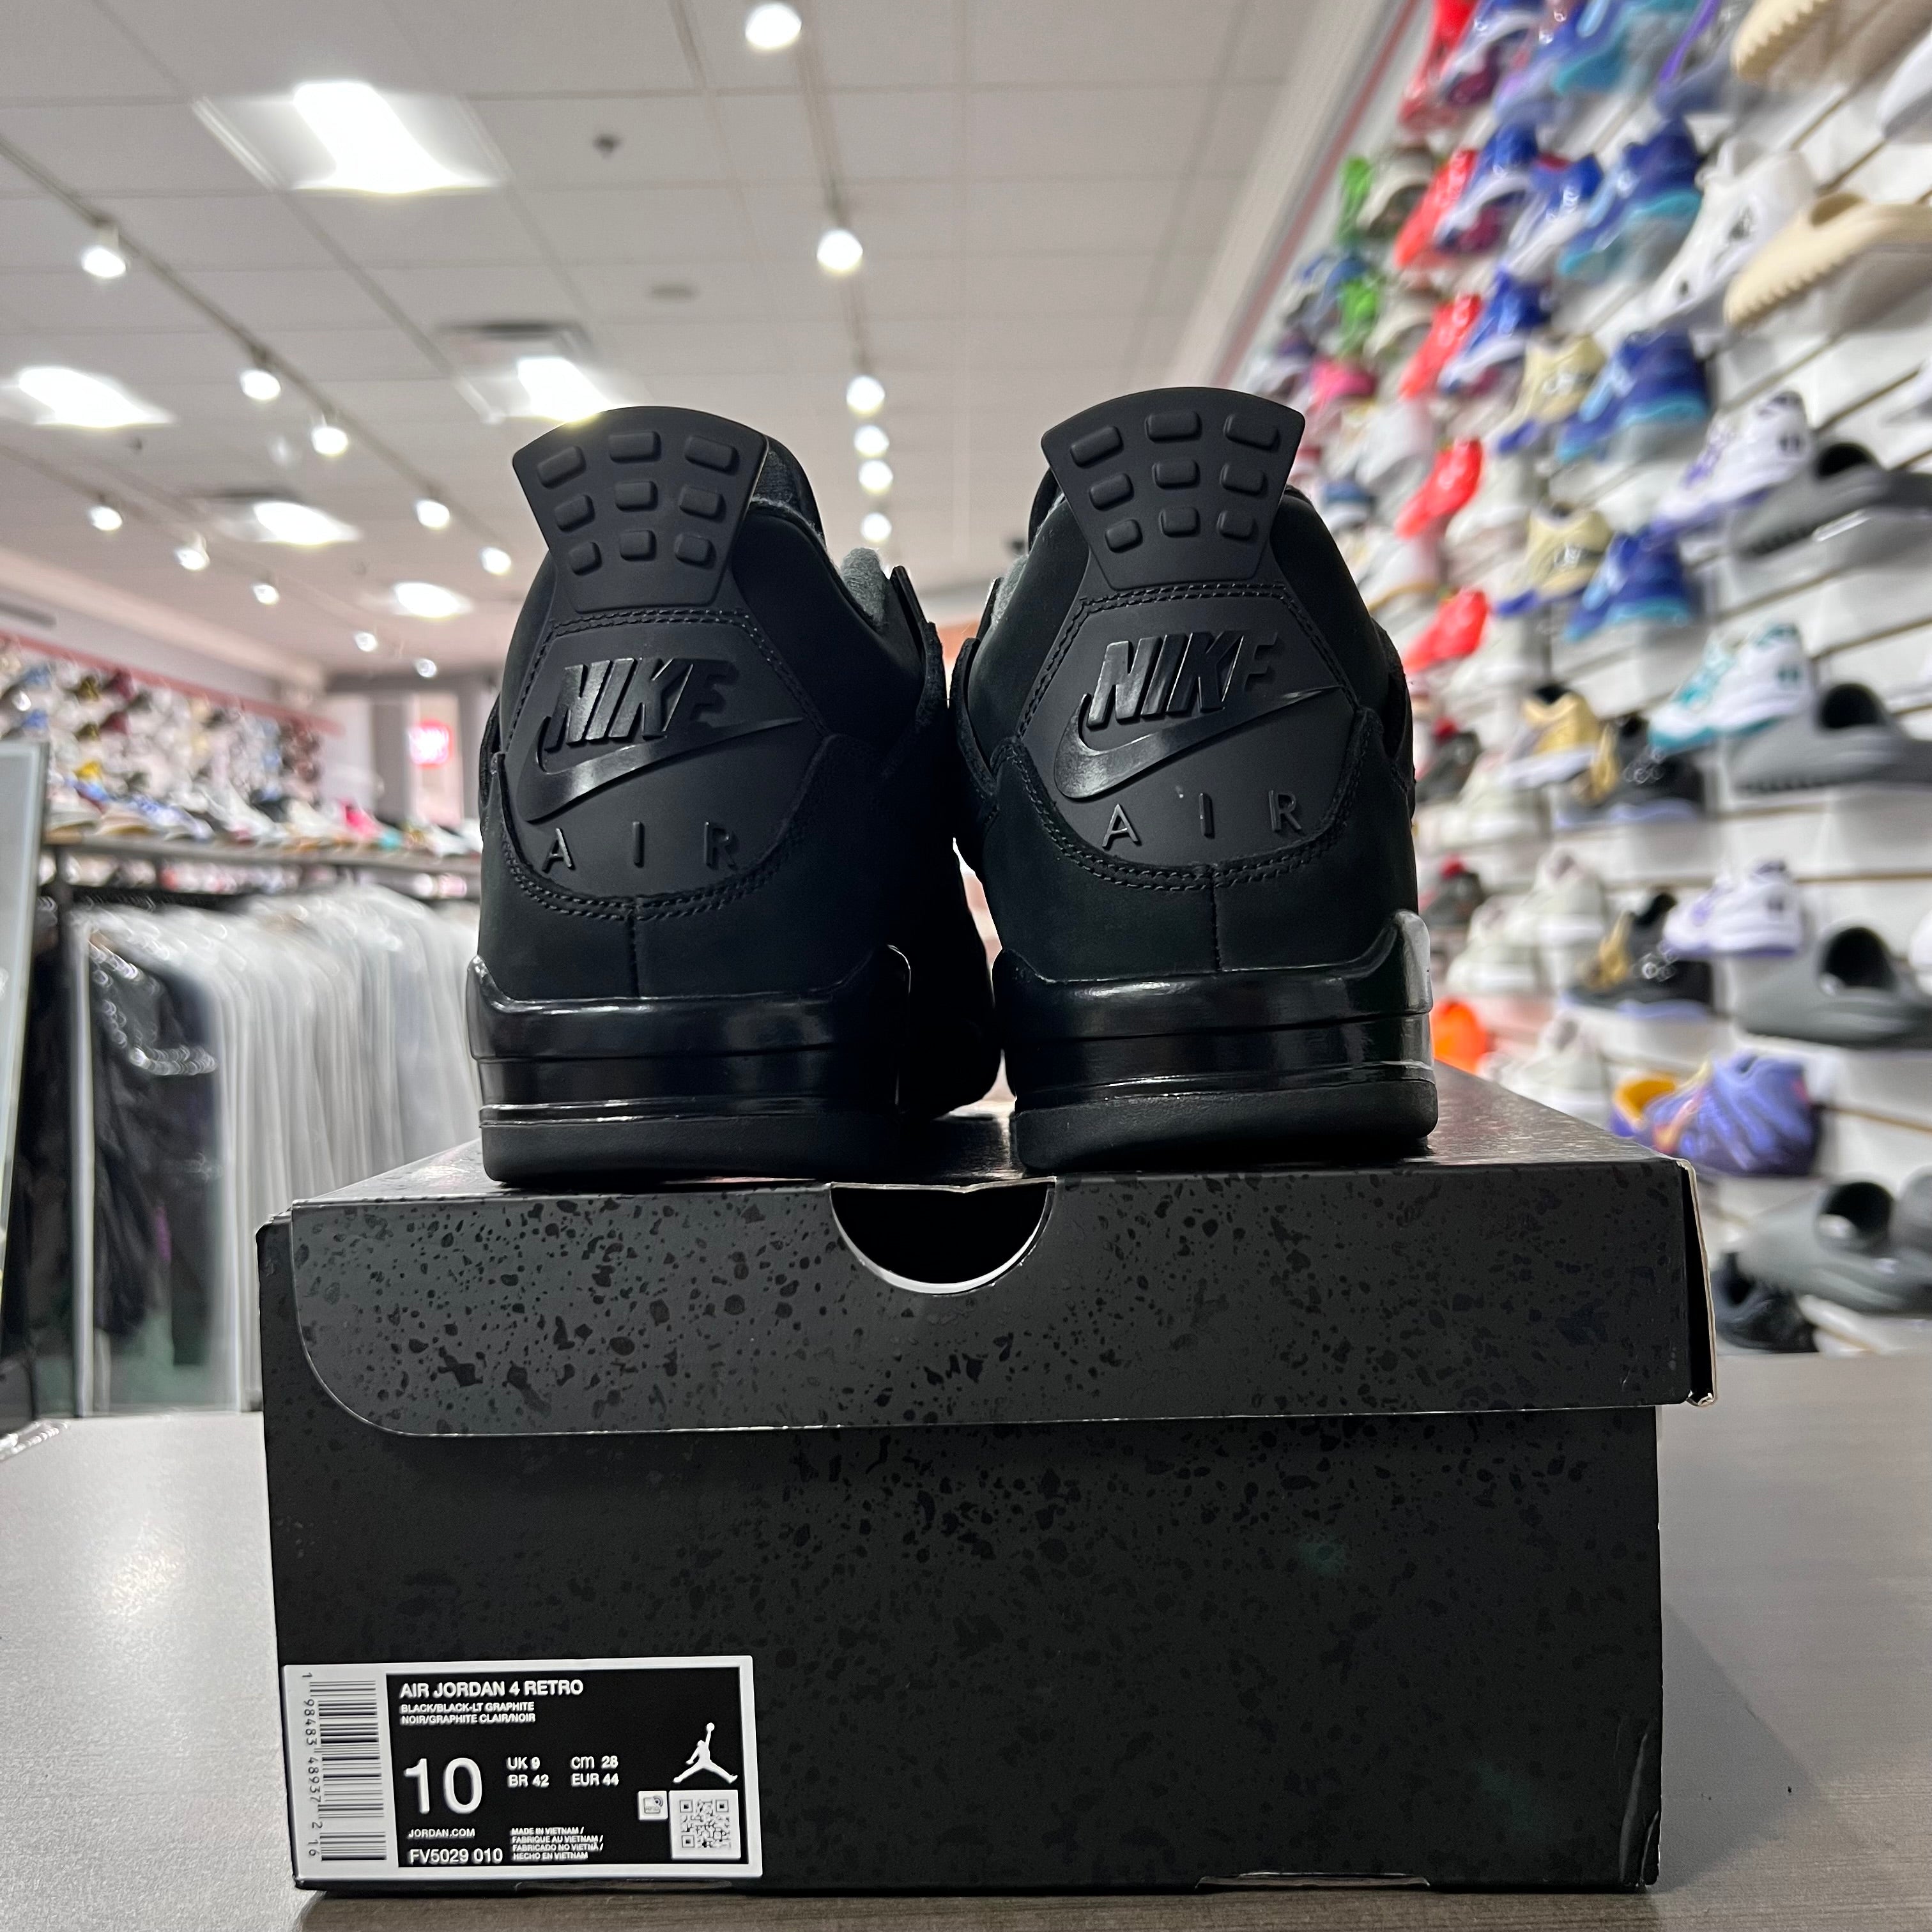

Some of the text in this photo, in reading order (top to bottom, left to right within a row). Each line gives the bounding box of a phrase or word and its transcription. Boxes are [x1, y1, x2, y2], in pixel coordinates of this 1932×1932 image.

[1087, 631, 1278, 728] NIKE
[544, 657, 740, 753] NIKE
[399, 1679, 584, 1698] AIR JORDAN 4 RETRO
[485, 1701, 535, 1712] GRAPHITE
[303, 1699, 318, 1745] 98483
[401, 1713, 535, 1725] NOIR/GRAPHITE CLAIR/NOIR
[507, 1757, 540, 1770] UK 9
[601, 1756, 618, 1768] 28
[308, 1757, 321, 1802] 48937
[404, 1757, 482, 1814] 10
[507, 1774, 549, 1788] BR 42
[571, 1774, 619, 1786] EUR 44
[408, 1828, 475, 1839] JORDAN.COM
[409, 1848, 503, 1864] FV5029 010
